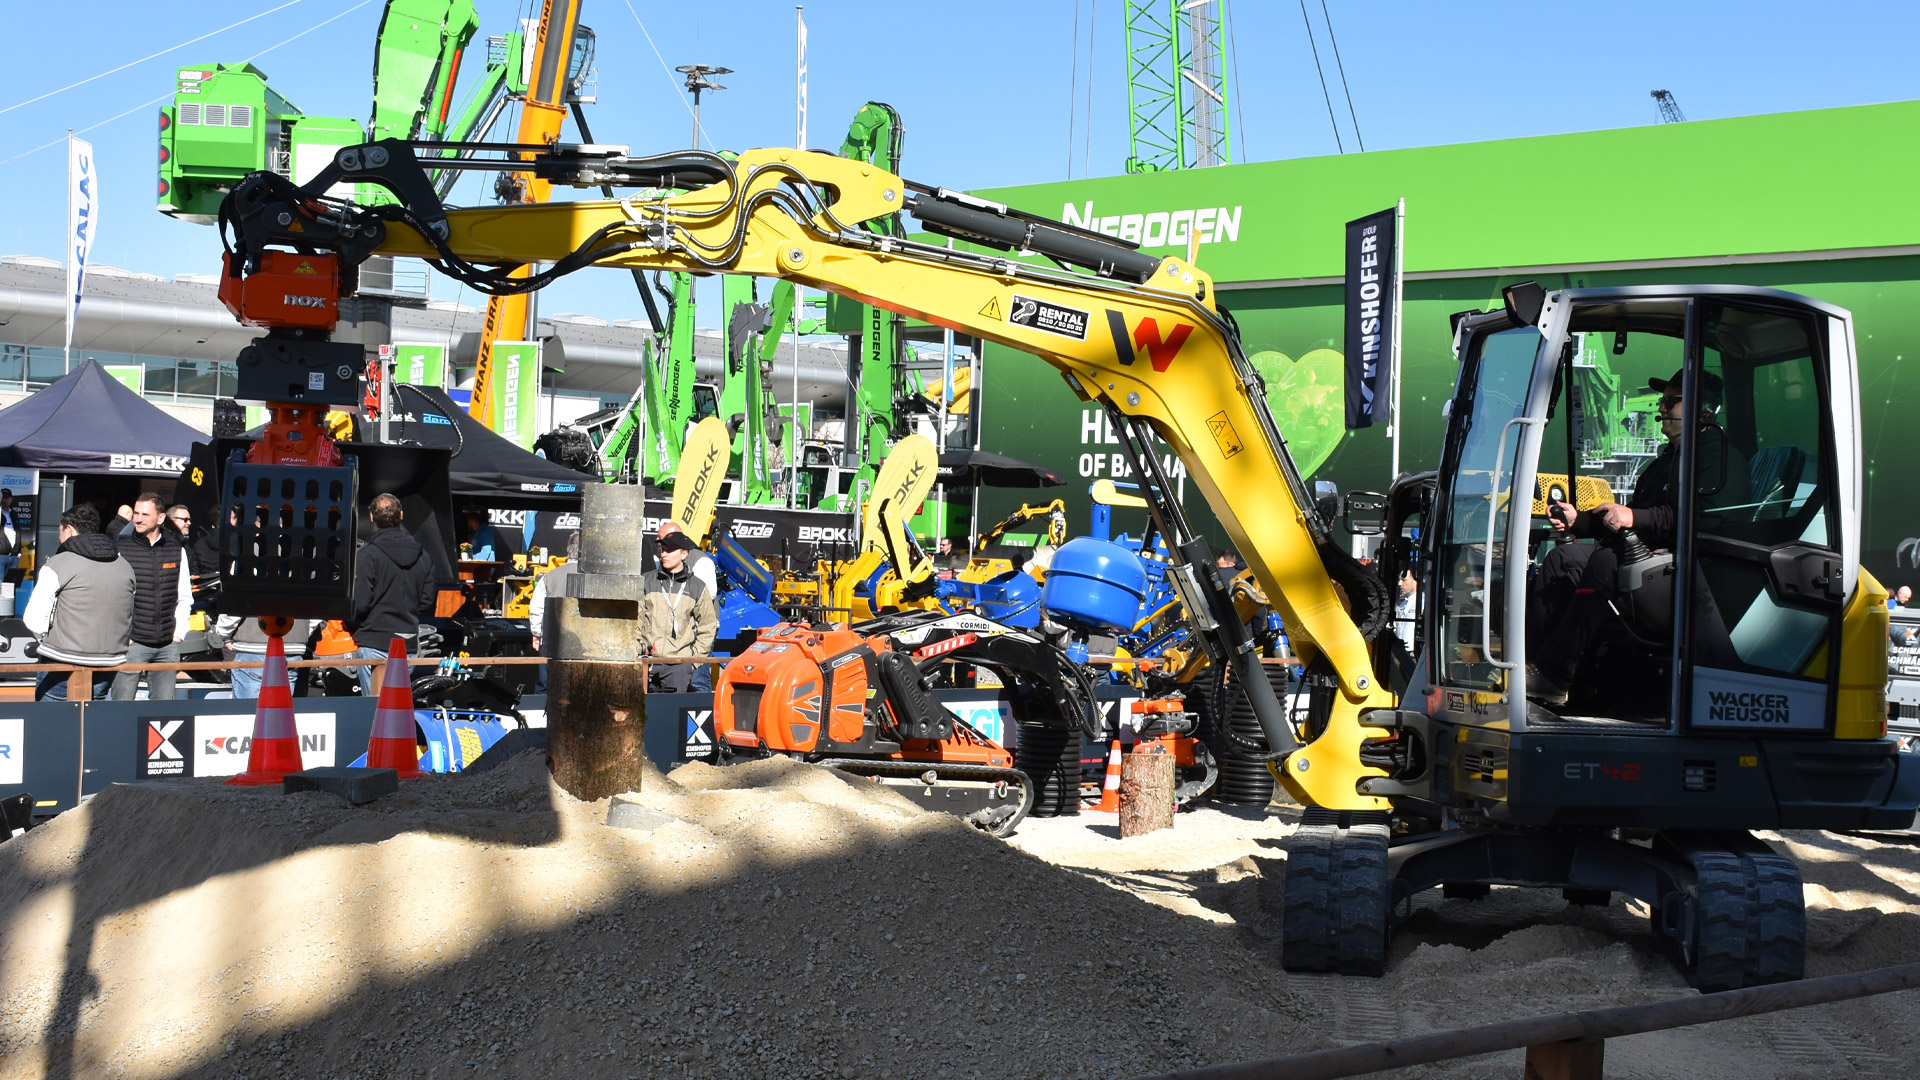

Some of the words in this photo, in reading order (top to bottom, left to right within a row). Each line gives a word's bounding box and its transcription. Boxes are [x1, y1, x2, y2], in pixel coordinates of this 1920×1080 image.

[75, 153, 90, 304] CALAC
[283, 294, 326, 309] nox
[1360, 235, 1381, 379] KINSHOFER
[1039, 306, 1084, 327] RENTAL
[474, 341, 490, 403] FRANZ
[109, 454, 187, 472] BROKK
[1079, 453, 1106, 477] OF
[682, 443, 720, 525] BROKK
[488, 509, 524, 524] OKK
[729, 519, 776, 538] darda
[960, 622, 990, 630] CORMIDI
[1708, 691, 1790, 709] WACKER
[1709, 706, 1790, 724] NEUSON
[225, 734, 326, 755] CANI
[1563, 762, 1641, 781] ET42
